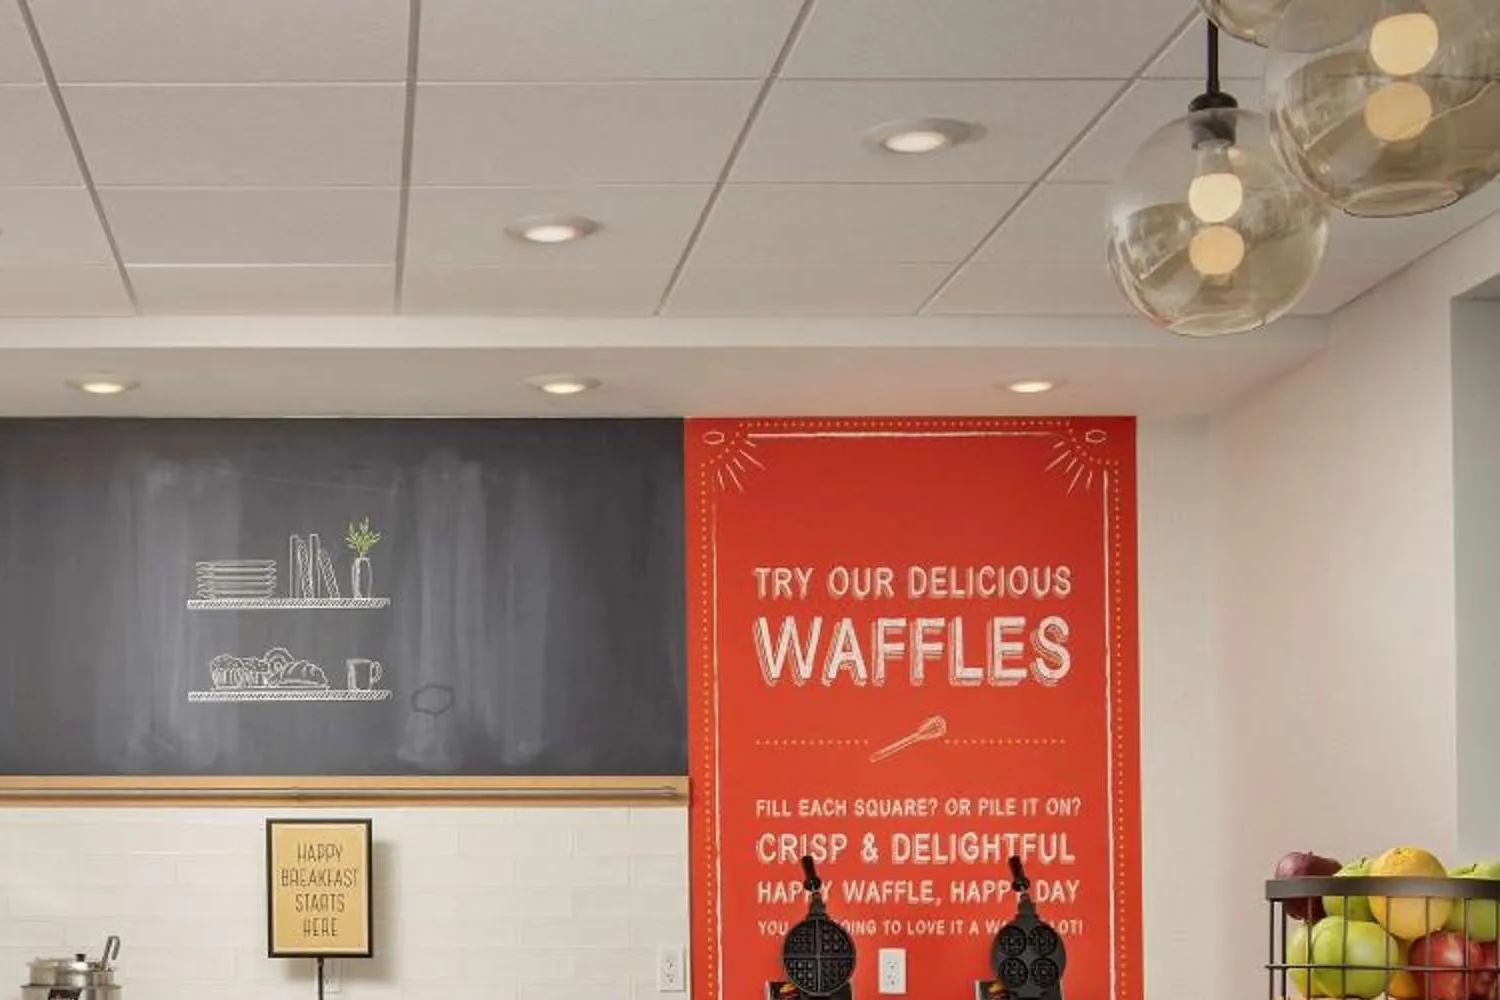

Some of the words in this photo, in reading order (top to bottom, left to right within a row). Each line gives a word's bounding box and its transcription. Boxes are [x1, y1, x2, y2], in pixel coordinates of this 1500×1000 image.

[753, 566, 814, 600] TRY
[827, 565, 895, 601] OUR
[908, 564, 1072, 600] DELICIOUS
[752, 615, 1071, 688] WAFFLES
[756, 798, 792, 818] FILL
[798, 798, 847, 818] EACH
[854, 797, 938, 818] SQUARE?
[944, 798, 971, 817] OR
[978, 798, 1017, 817] PILE
[1023, 798, 1039, 816] IT
[1045, 797, 1082, 817] ON?
[297, 843, 343, 863] HAPPY
[756, 832, 848, 865] CRISP
[860, 831, 880, 864] &
[891, 831, 1076, 865] DELIGHTFUL
[280, 867, 358, 887] BREAKFAST
[295, 893, 345, 913] STARTS
[842, 880, 941, 906] WAFFLE,
[950, 880, 1023, 903] HAPP
[1036, 880, 1081, 903] DAY
[303, 917, 340, 937] HERE
[834, 919, 877, 936] OING
[884, 920, 902, 936] TO
[907, 920, 946, 936] LOVE
[951, 920, 964, 935] IT
[968, 920, 980, 935] A
